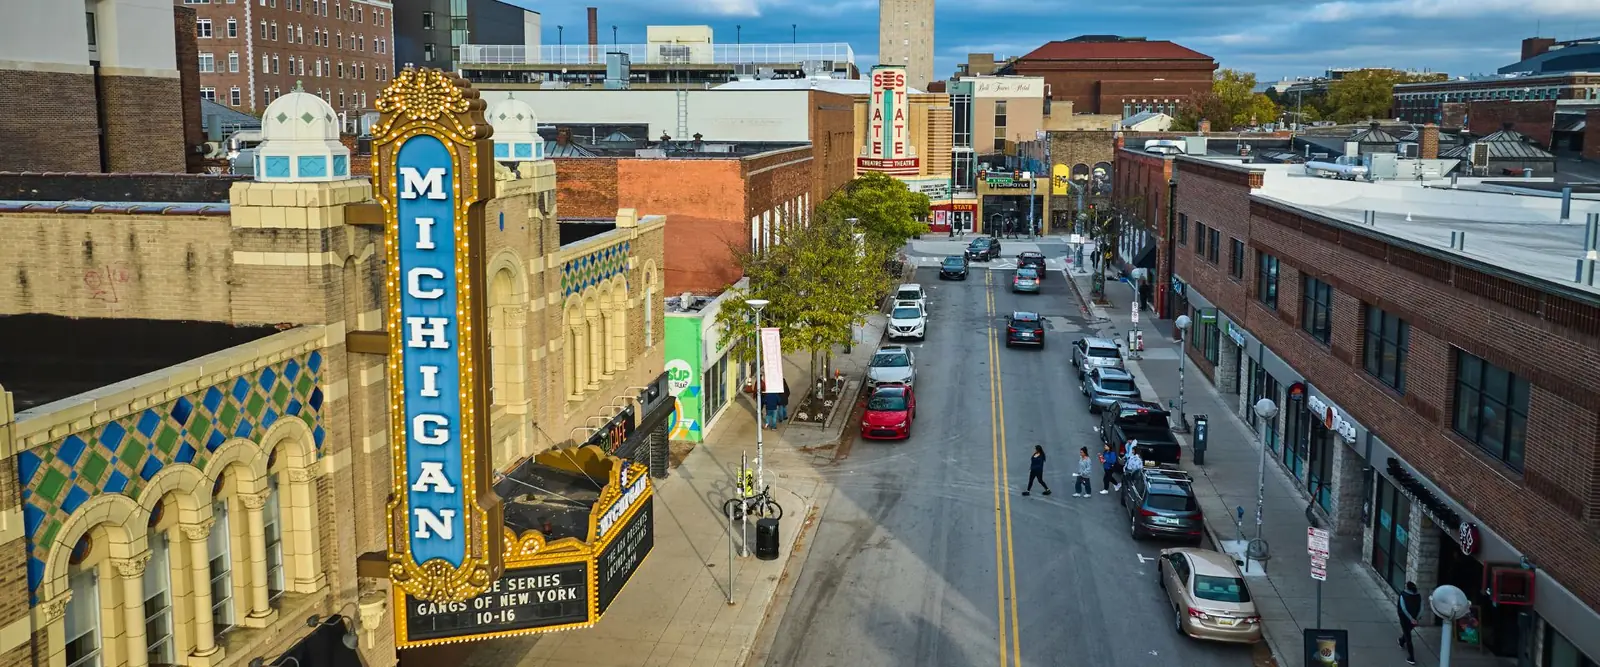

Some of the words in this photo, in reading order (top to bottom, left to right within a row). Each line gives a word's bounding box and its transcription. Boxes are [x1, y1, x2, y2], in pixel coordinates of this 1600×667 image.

[873, 74, 882, 155] STATE
[894, 74, 904, 155] STATE
[861, 159, 882, 167] THEATRE
[893, 159, 915, 167] THEATRE
[399, 166, 456, 540] MICHIGAN
[610, 419, 627, 453] CAFE
[600, 473, 647, 537] MICHIGAN
[607, 548, 616, 567] THE
[617, 536, 626, 553] ARK
[626, 511, 648, 545] PRESENTS
[417, 600, 468, 616] GANGS
[474, 596, 493, 609] OF
[500, 592, 529, 607] NEW
[537, 587, 577, 603] YORK
[507, 573, 561, 591] SERIES
[477, 609, 516, 625] 10-16
